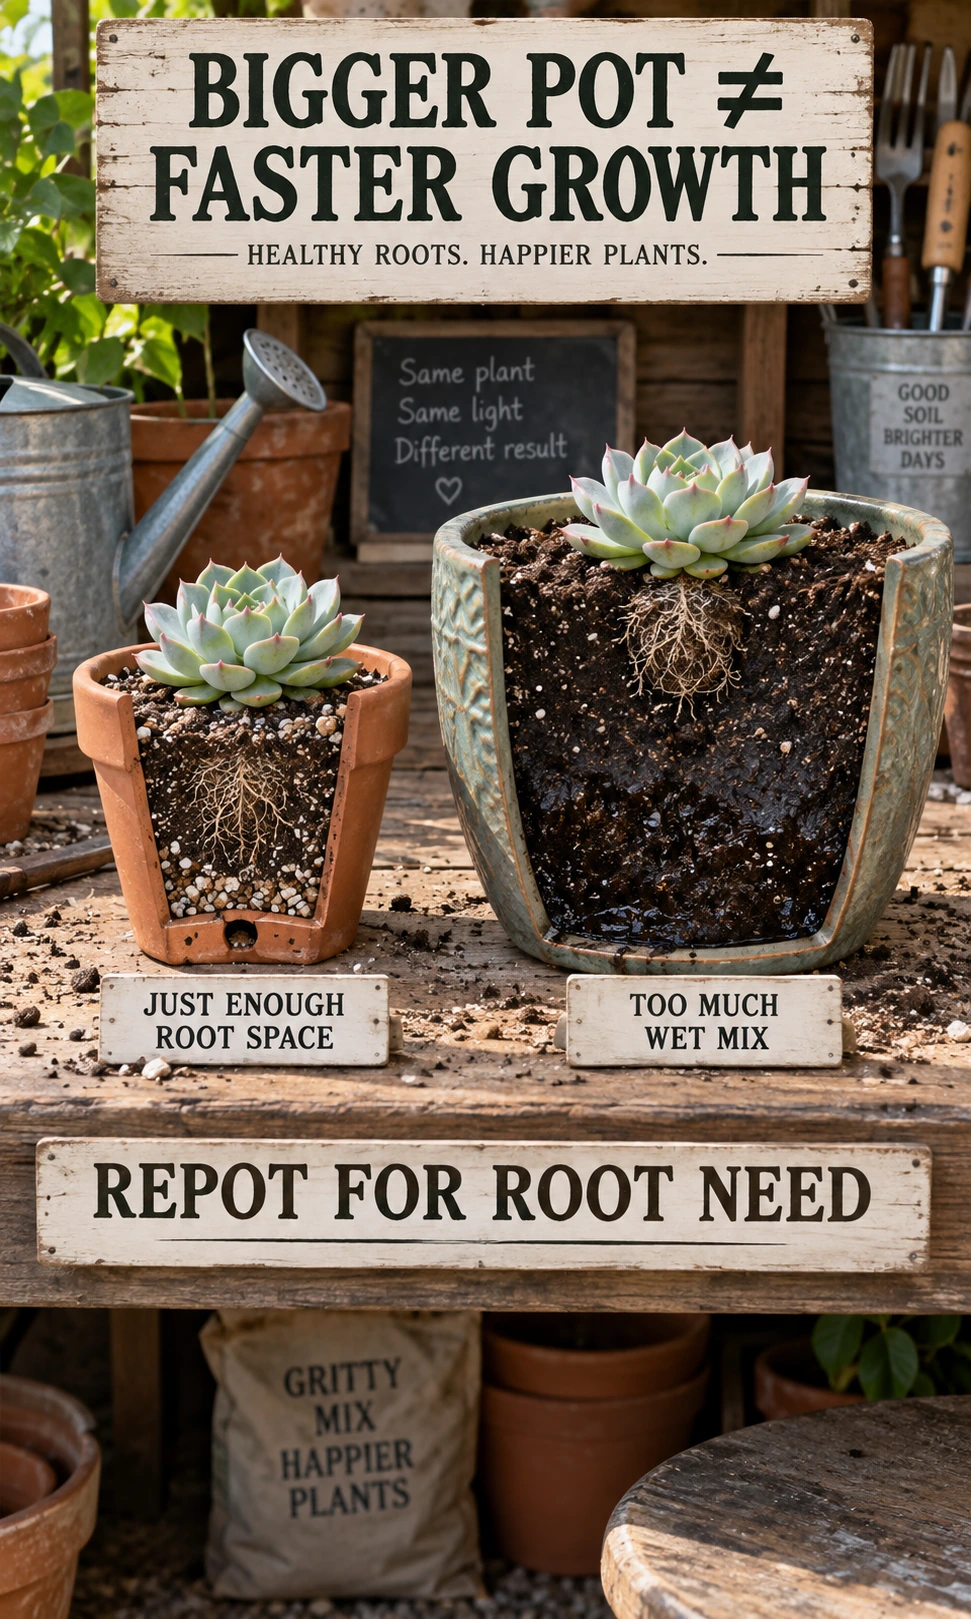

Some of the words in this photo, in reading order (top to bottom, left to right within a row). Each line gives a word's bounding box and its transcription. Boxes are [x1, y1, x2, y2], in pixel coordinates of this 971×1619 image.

[189, 52, 497, 128] BIGGER
[527, 52, 685, 128] POT
[718, 53, 783, 129] ≠
[149, 145, 462, 222] FASTER
[492, 145, 827, 222] GROWTH
[248, 245, 362, 265] HEALTHY
[376, 244, 467, 265] ROOTS.
[481, 245, 591, 265] HAPPIER
[604, 244, 707, 265] PLANTS.
[399, 357, 465, 386] Same
[475, 356, 535, 393] plant
[898, 384, 949, 401] GOOD
[397, 397, 461, 425] Same
[472, 395, 523, 432] light
[905, 407, 943, 424] SOIL
[395, 435, 495, 467] Different
[504, 432, 567, 460] result
[885, 429, 963, 446] BRIGHTER
[901, 451, 945, 469] DAYS
[144, 993, 213, 1016] JUST
[226, 993, 344, 1016] ENOUGH
[630, 994, 687, 1016] TOO
[699, 994, 778, 1016] MUCH
[156, 1026, 234, 1049] ROOT
[247, 1026, 333, 1049] SPACE
[645, 1027, 705, 1049] WET
[717, 1027, 769, 1049] MIX
[94, 1163, 307, 1220] REPOT
[335, 1163, 466, 1220] FOR
[493, 1164, 673, 1222] ROOT
[699, 1166, 871, 1222] NEED
[284, 1358, 400, 1397] GRITTY
[315, 1402, 374, 1435] MIX
[281, 1439, 414, 1481] HAPPIER
[289, 1478, 410, 1518] PLANTS
